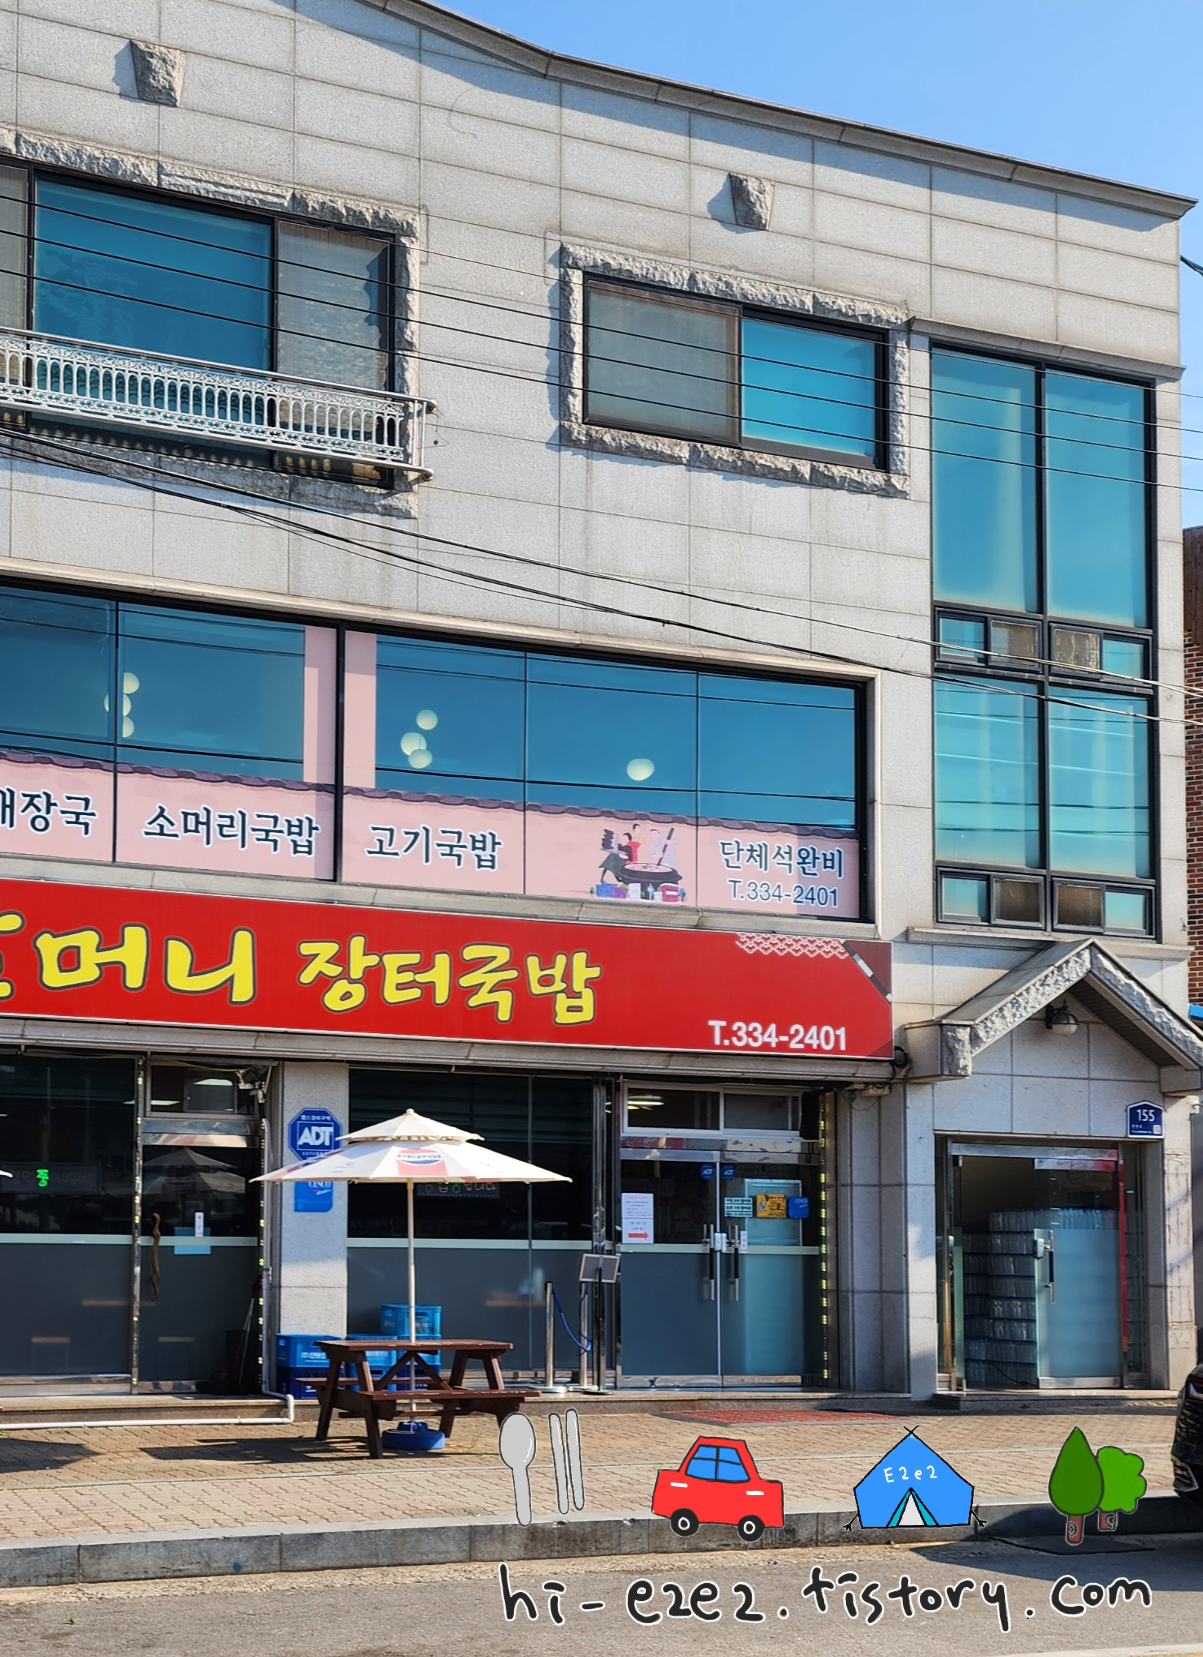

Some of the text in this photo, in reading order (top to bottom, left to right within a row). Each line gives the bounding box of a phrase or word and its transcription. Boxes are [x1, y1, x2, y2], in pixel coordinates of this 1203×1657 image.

[142, 802, 321, 857] 소머리국밥
[366, 824, 502, 871] 고기국밥
[719, 838, 845, 879] 단체석완비
[727, 878, 840, 908] T.334-2401
[298, 933, 603, 1026] 장터국밥
[708, 1020, 847, 1052] T.334-2401
[1137, 1109, 1155, 1121] 155
[298, 1126, 334, 1146] ADT
